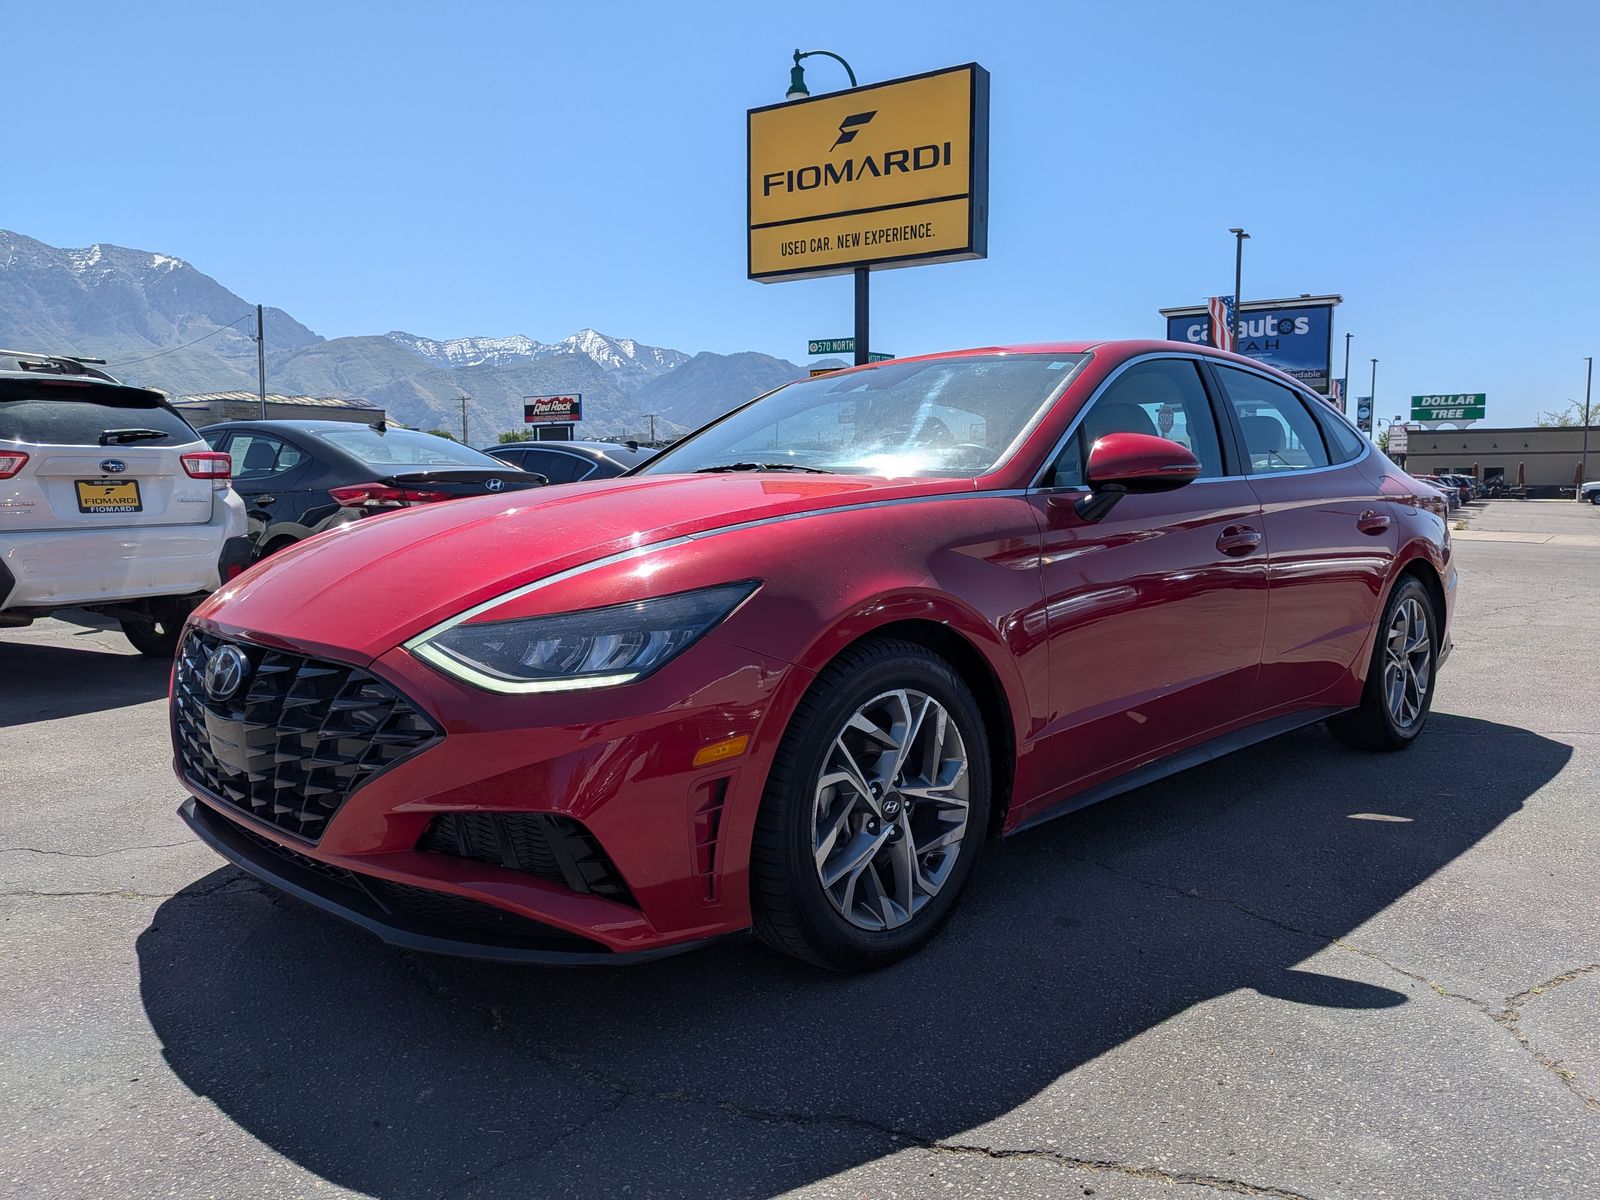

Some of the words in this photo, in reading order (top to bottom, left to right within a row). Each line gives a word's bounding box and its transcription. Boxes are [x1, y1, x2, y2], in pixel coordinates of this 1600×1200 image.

[763, 141, 951, 197] FIOMARDI
[781, 240, 806, 257] USED
[810, 237, 833, 253] CAR.
[837, 232, 861, 249] NEW
[864, 222, 936, 246] EXPERIENCE.
[818, 342, 831, 352] 570
[832, 340, 854, 351] NORTH
[1421, 395, 1475, 406] DOLLAR
[533, 403, 551, 415] Red
[551, 400, 572, 412] Rock
[1430, 408, 1465, 419] TREE
[84, 497, 137, 505] FIOMARDI
